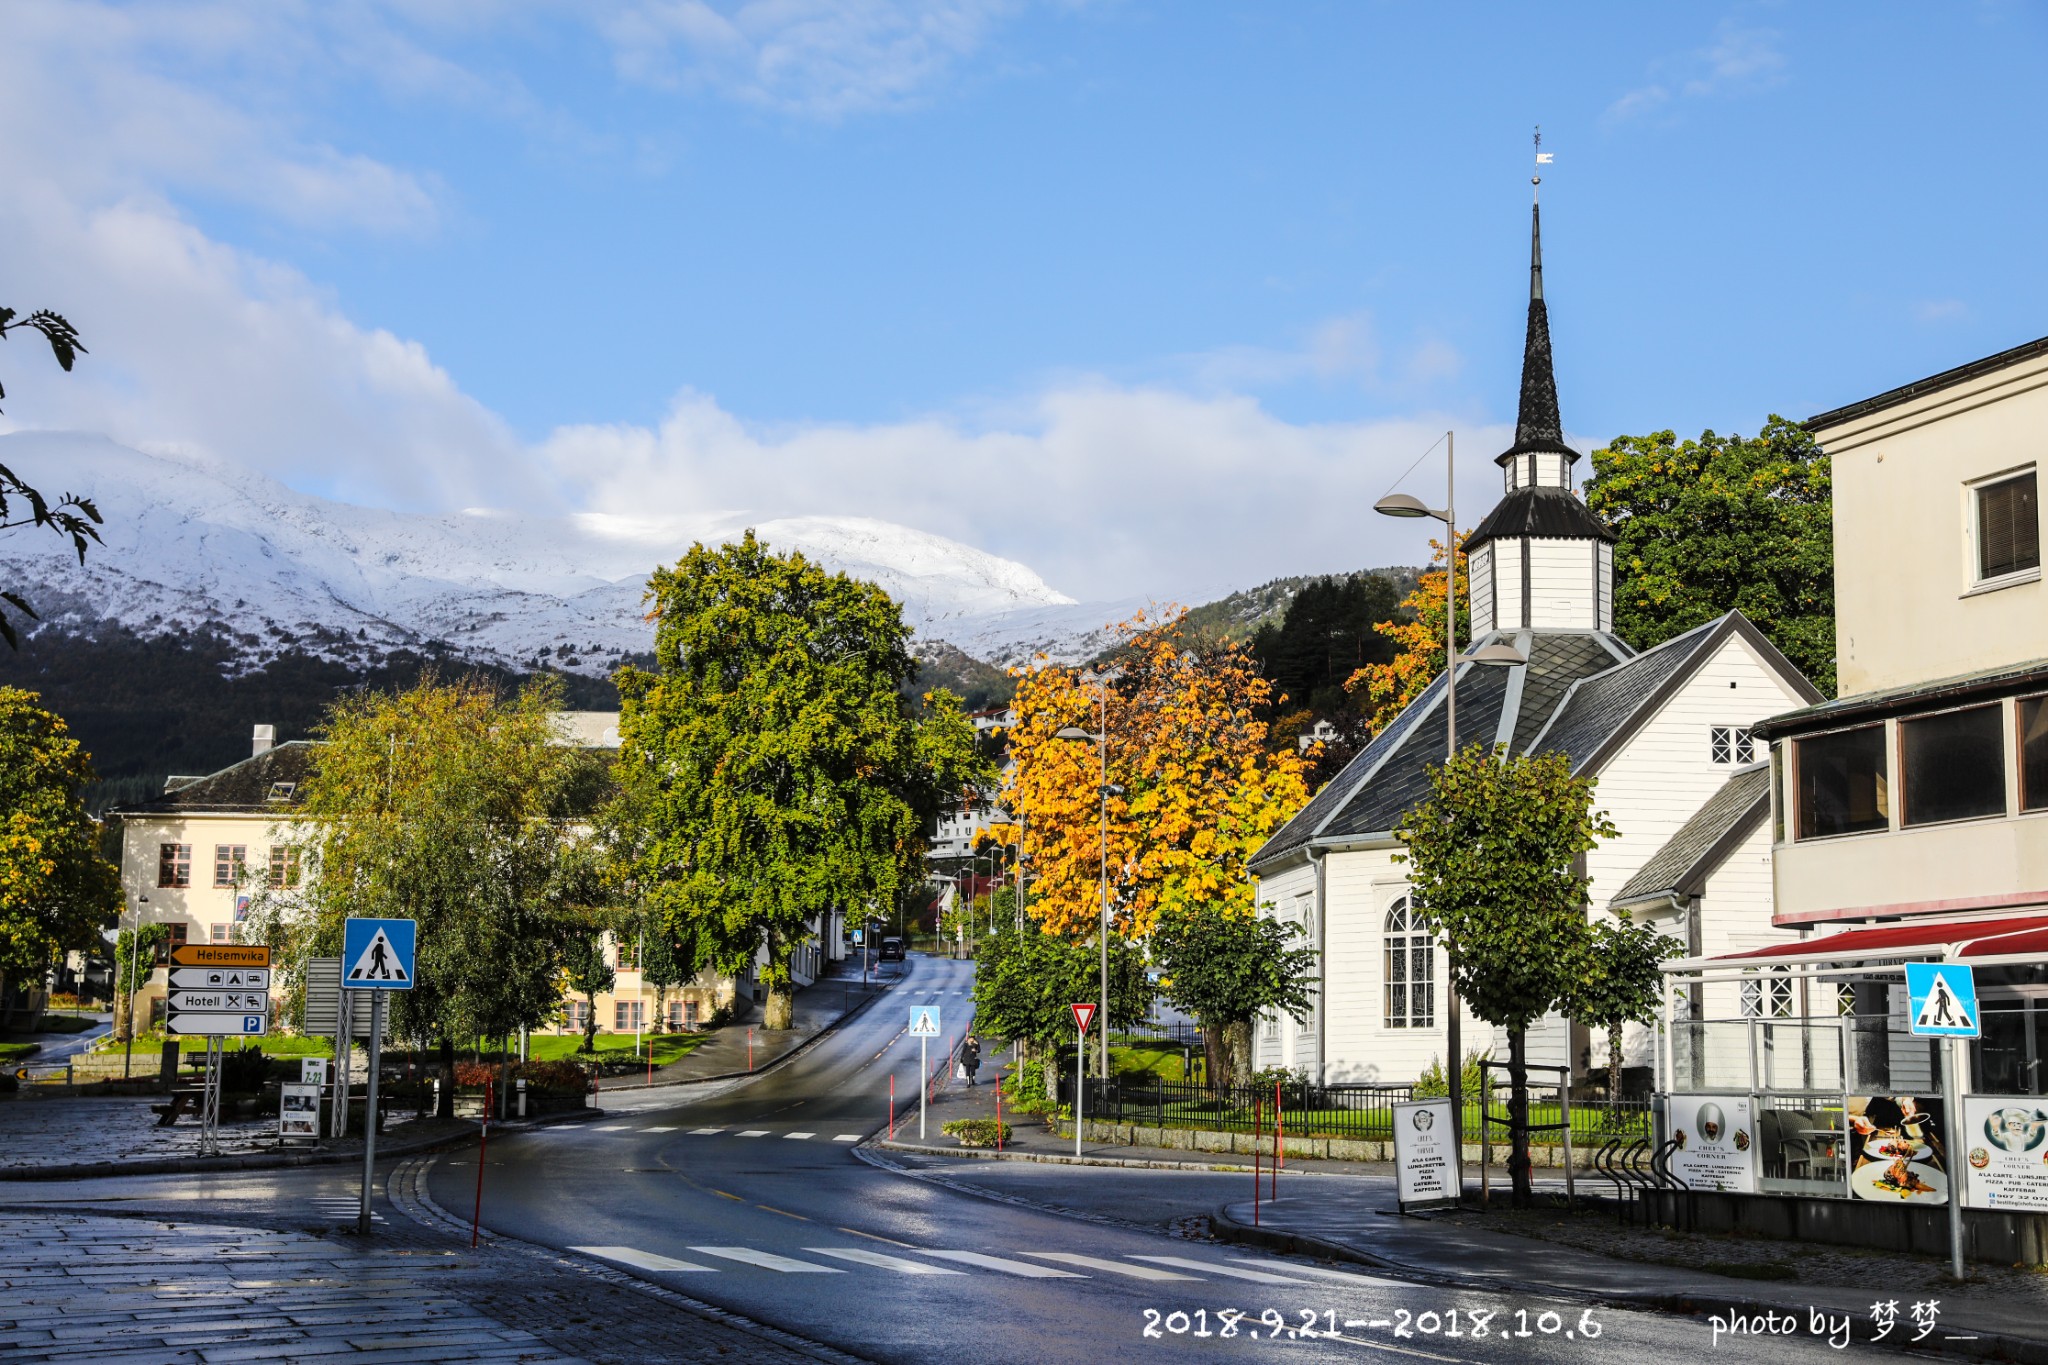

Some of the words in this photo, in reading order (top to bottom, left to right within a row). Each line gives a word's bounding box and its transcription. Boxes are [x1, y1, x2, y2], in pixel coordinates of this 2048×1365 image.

[197, 950, 264, 961] Helsemvika
[185, 996, 220, 1006] Hotell
[247, 1018, 257, 1031] P
